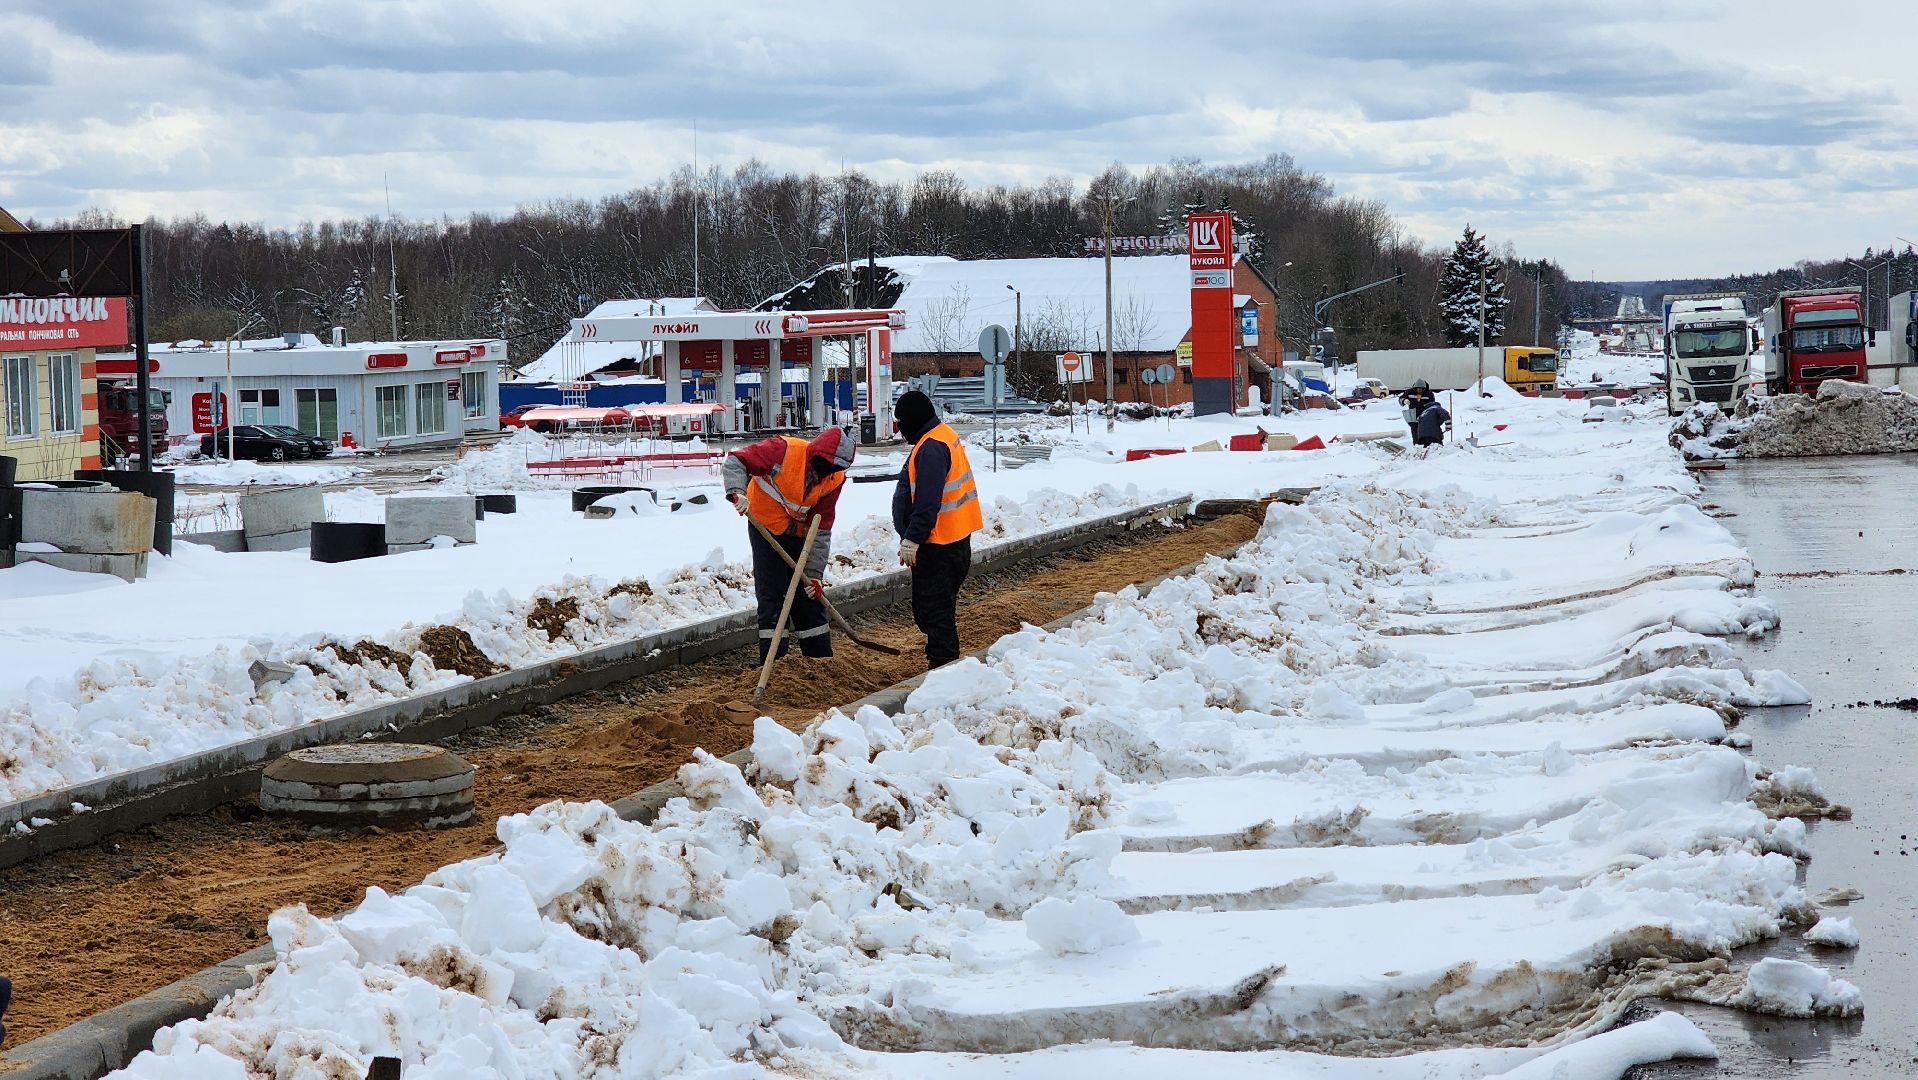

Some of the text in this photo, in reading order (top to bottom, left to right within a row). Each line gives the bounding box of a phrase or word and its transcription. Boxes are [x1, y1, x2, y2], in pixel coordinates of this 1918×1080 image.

[1191, 256, 1225, 266] ЛУКОЙЛ
[1208, 276, 1226, 285] 100
[0, 298, 108, 324] МПОНЧИК
[652, 321, 699, 334] ЛУКОЙЛ
[0, 328, 80, 340] РАЛЬНАЯ ПОНЧИКОВАЯ СЕТЬ
[693, 422, 699, 430] 6
